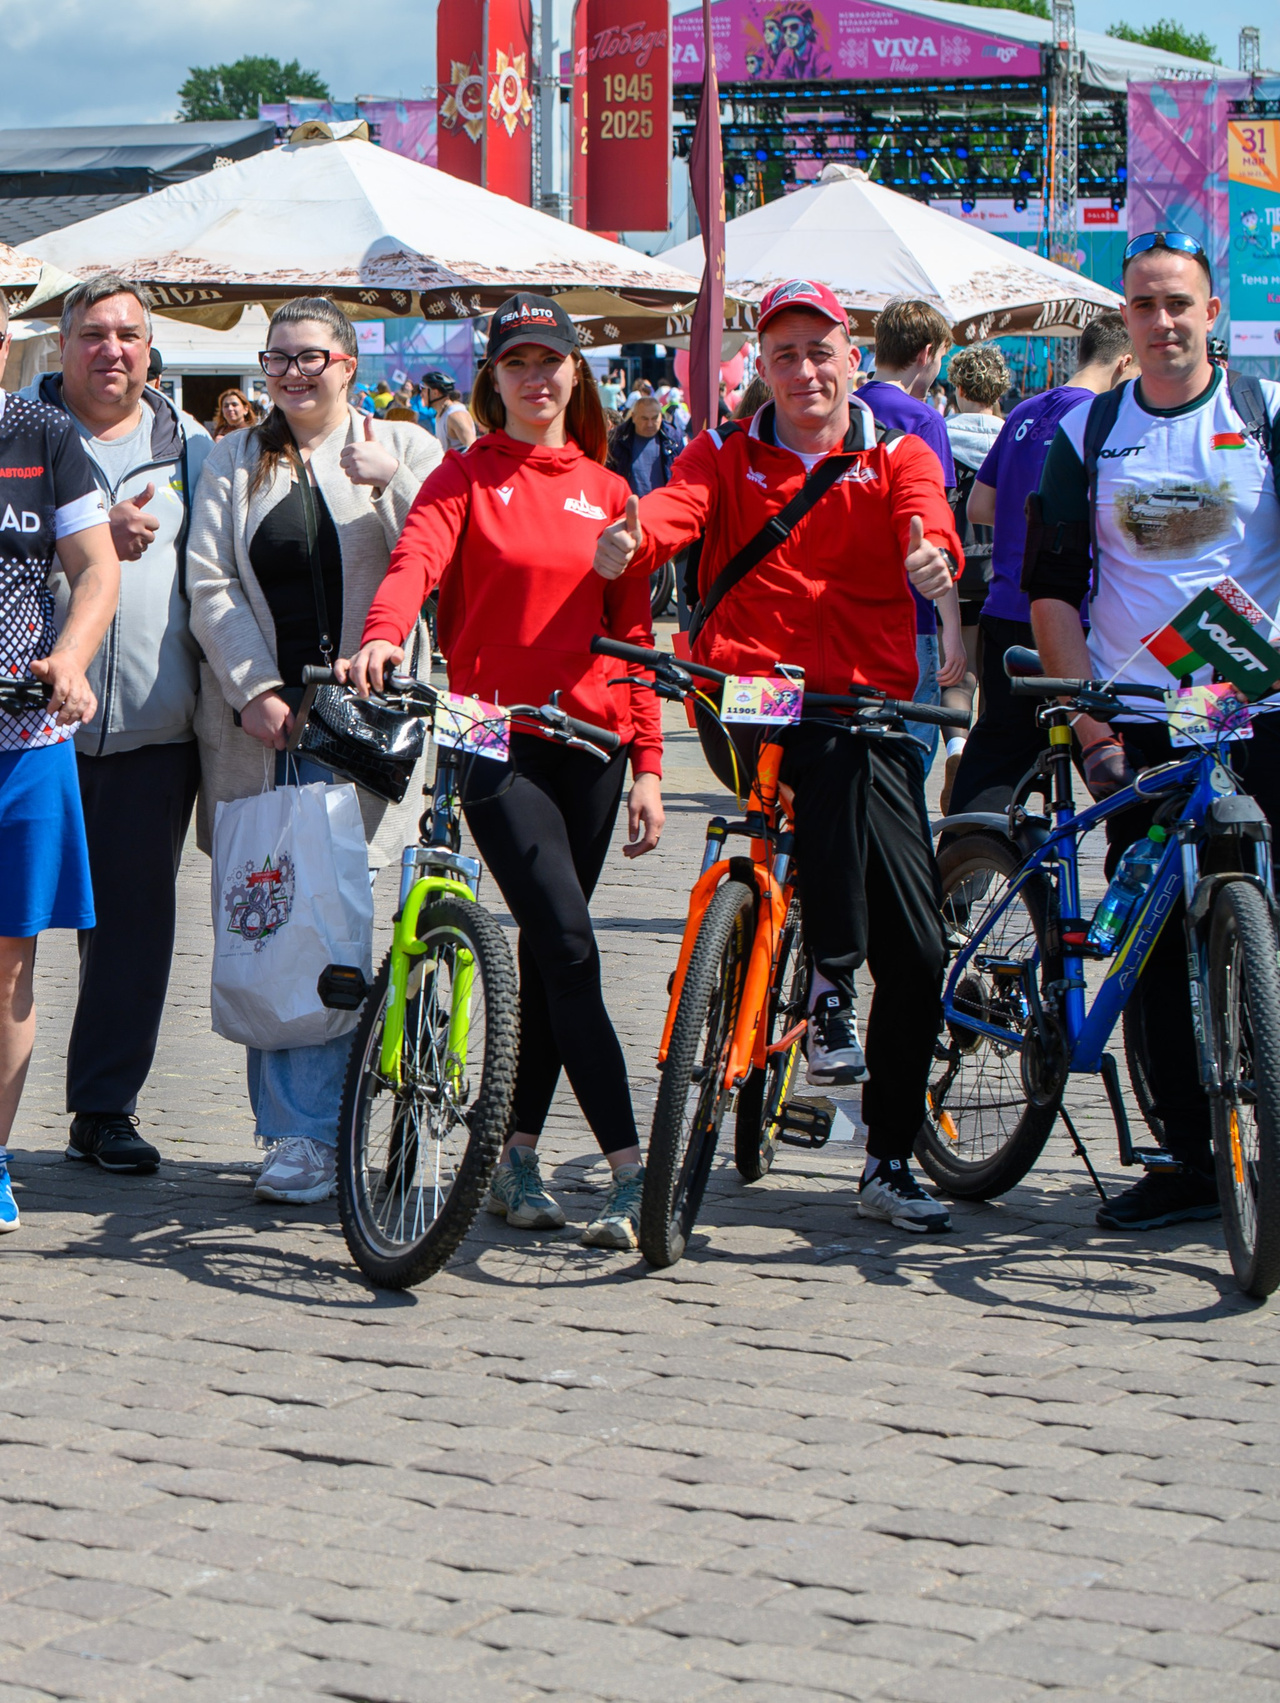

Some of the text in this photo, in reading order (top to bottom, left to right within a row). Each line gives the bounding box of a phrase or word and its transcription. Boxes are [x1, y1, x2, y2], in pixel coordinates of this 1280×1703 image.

[872, 36, 938, 57] VIVA
[603, 74, 653, 102] 1945
[601, 111, 653, 139] 2025
[1242, 128, 1266, 153] 31
[1119, 873, 1181, 990] AUTHOR
